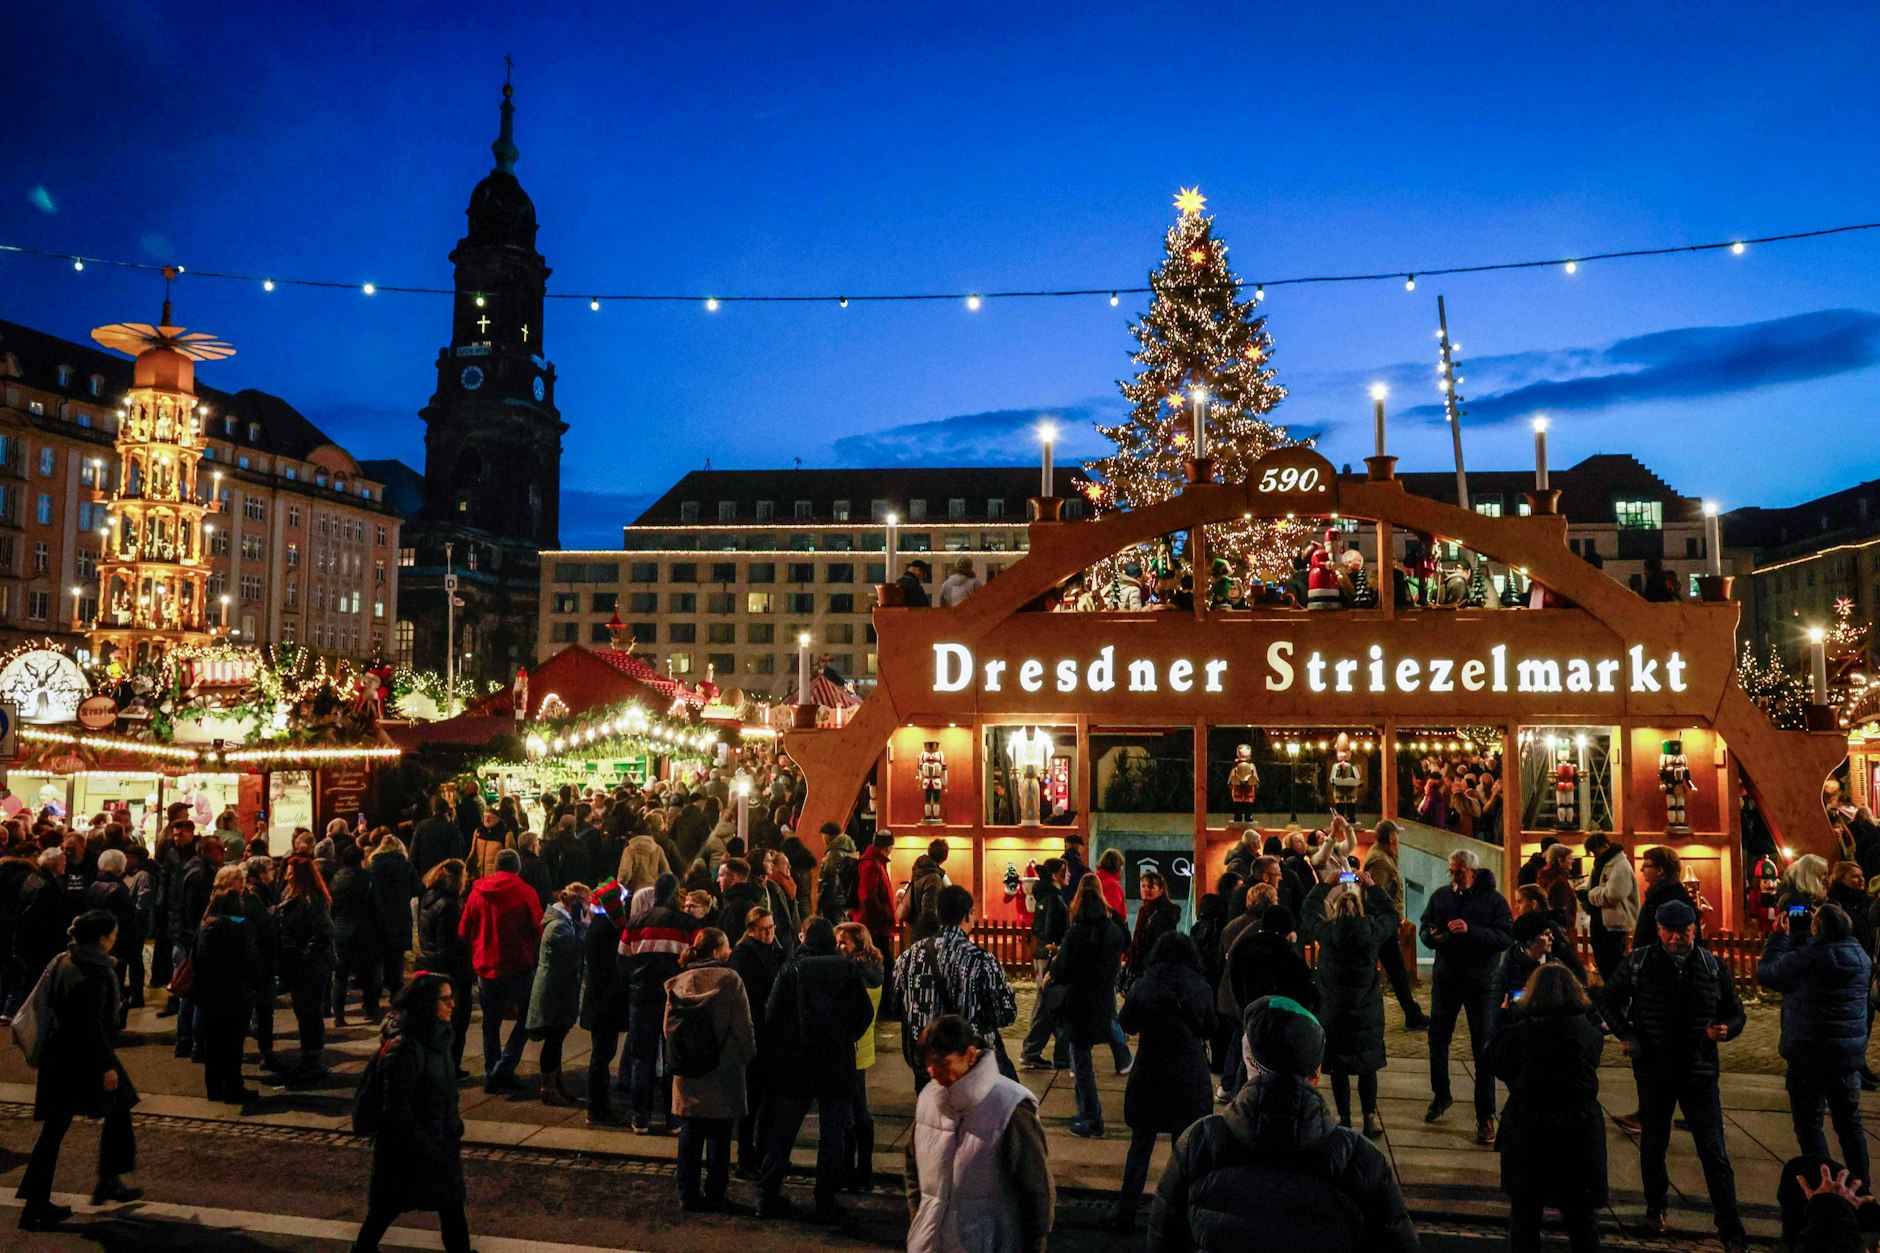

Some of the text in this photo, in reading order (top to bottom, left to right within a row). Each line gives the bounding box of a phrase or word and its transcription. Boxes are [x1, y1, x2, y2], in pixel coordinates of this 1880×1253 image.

[1259, 467, 1326, 493] 590.
[447, 579, 455, 588] D
[932, 641, 1687, 693] Dresdner Striezelmarkt
